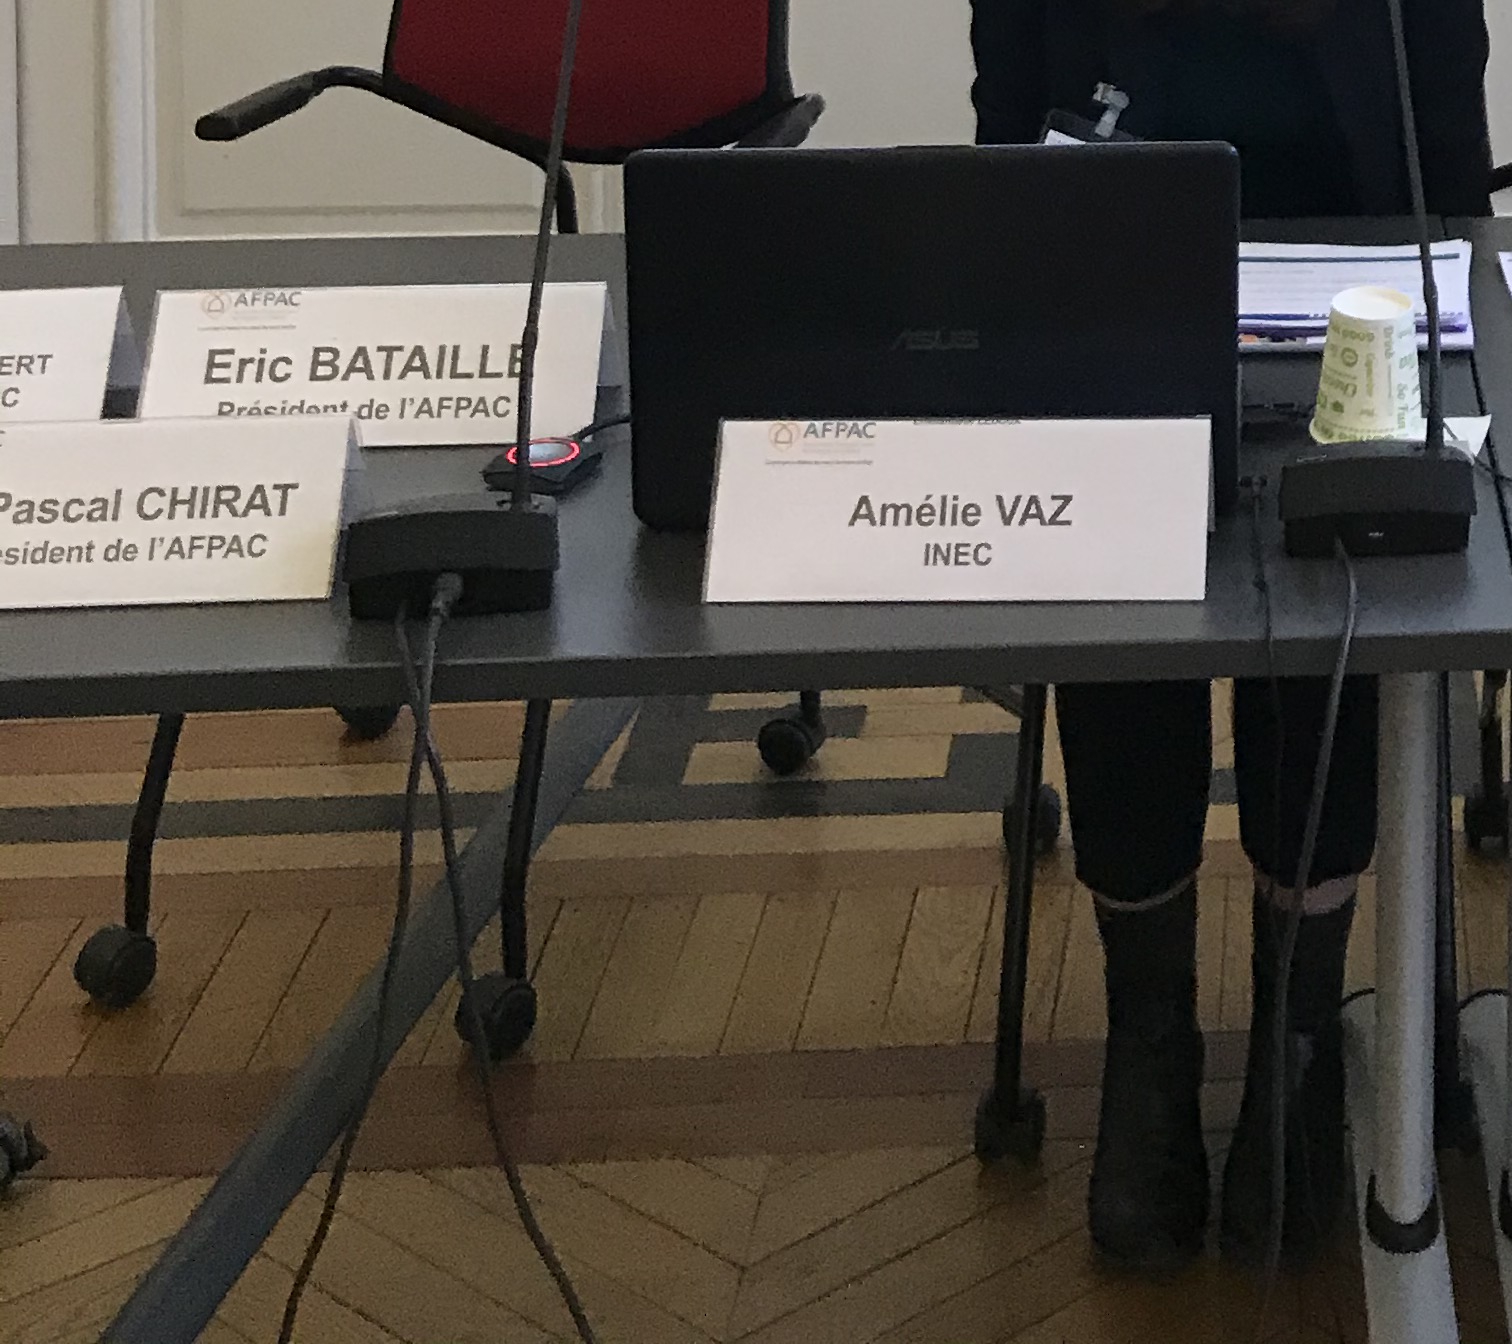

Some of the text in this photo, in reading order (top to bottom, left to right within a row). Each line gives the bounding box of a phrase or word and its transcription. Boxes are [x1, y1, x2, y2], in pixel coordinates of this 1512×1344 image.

[235, 291, 301, 308] AFPAC
[203, 343, 523, 385] Eric BATAILLE
[354, 398, 391, 421] de
[803, 421, 876, 439] AFPAC
[0, 482, 300, 525] Pascal CHIRAT
[847, 494, 1074, 527] Amélie VAZ
[103, 538, 139, 563] de
[923, 542, 993, 567] INEC
